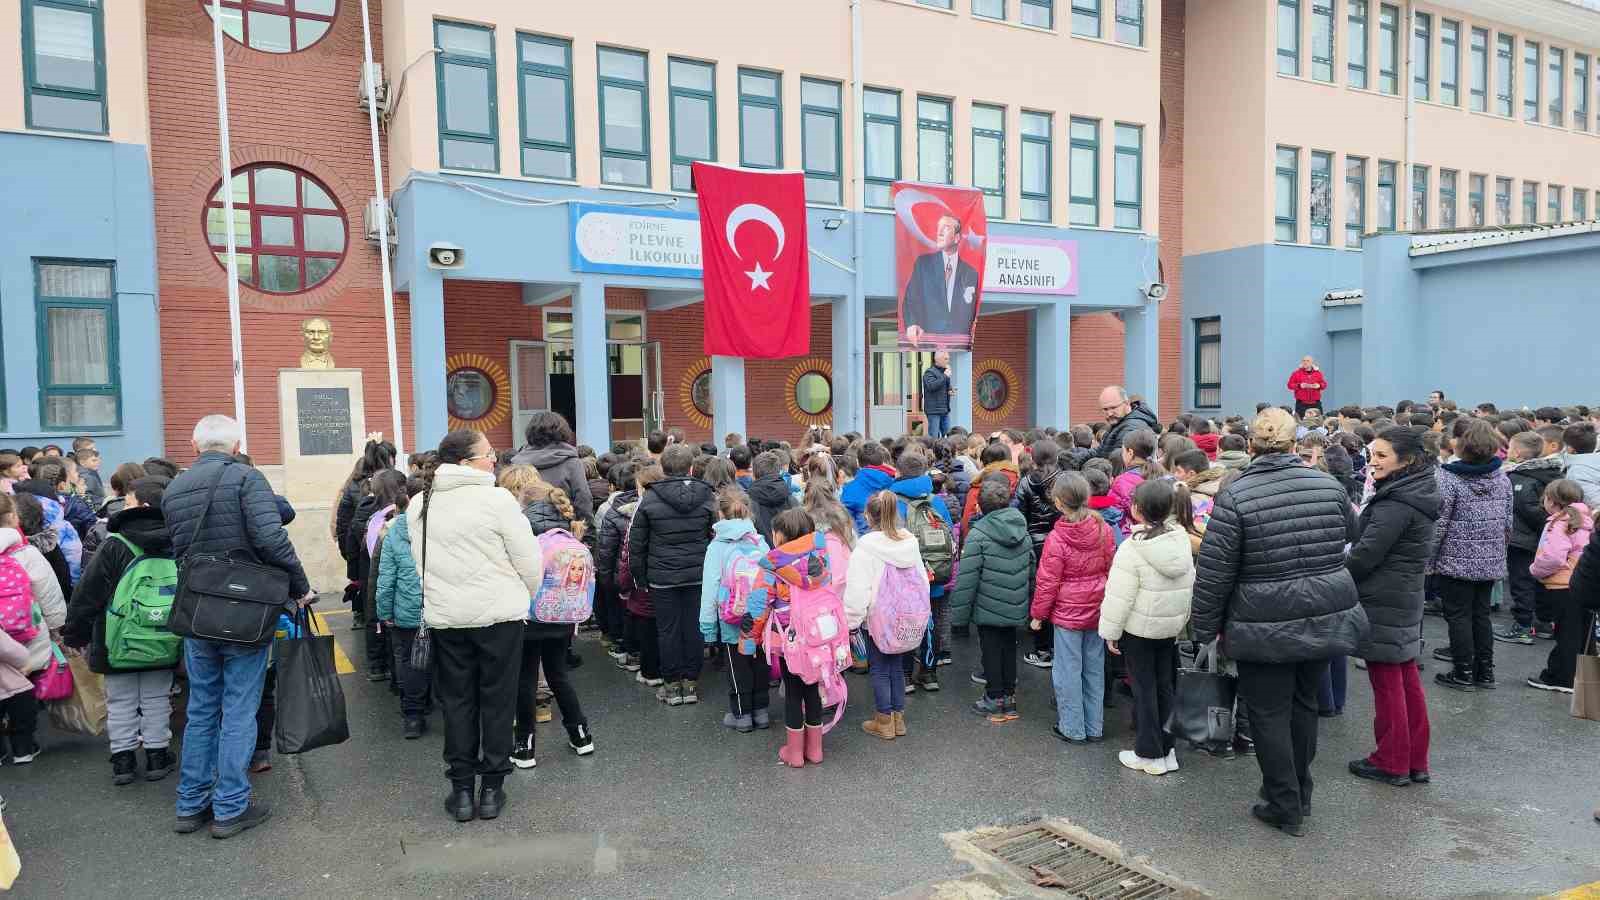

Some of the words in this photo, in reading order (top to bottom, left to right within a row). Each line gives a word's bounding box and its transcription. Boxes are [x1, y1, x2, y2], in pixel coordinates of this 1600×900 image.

[629, 233, 685, 248] PLEVNE
[997, 257, 1040, 271] PLEVNE
[999, 273, 1055, 287] ANASINIFI
